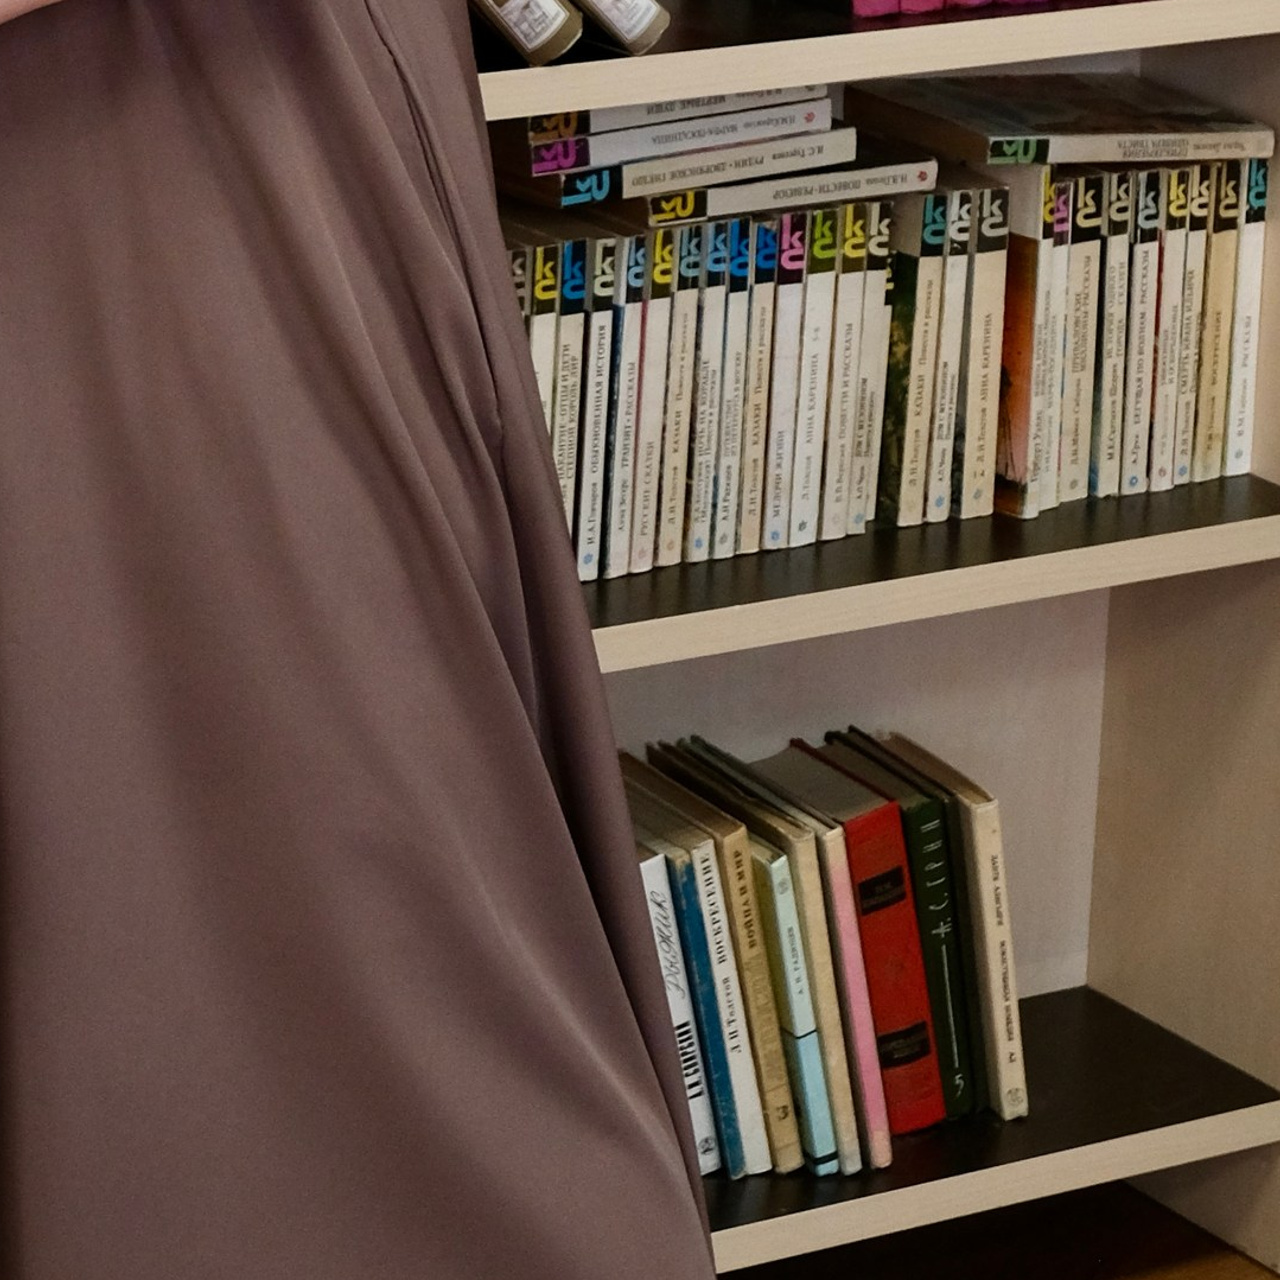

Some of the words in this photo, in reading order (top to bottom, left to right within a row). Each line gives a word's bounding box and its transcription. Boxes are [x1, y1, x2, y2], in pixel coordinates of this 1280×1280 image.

[595, 325, 605, 377] ИСТОРИЯ
[842, 323, 852, 377] РАССКАЗЫ
[982, 313, 992, 369] КАРЕНИНА
[592, 381, 603, 473] ОБЫКНОВЕННАЯ
[773, 473, 782, 517] МЕЛОЧИ
[734, 850, 745, 881] МИР
[700, 853, 727, 964] ВОСКРЕСЕНИЕ
[742, 898, 757, 948] ВОЙНА
